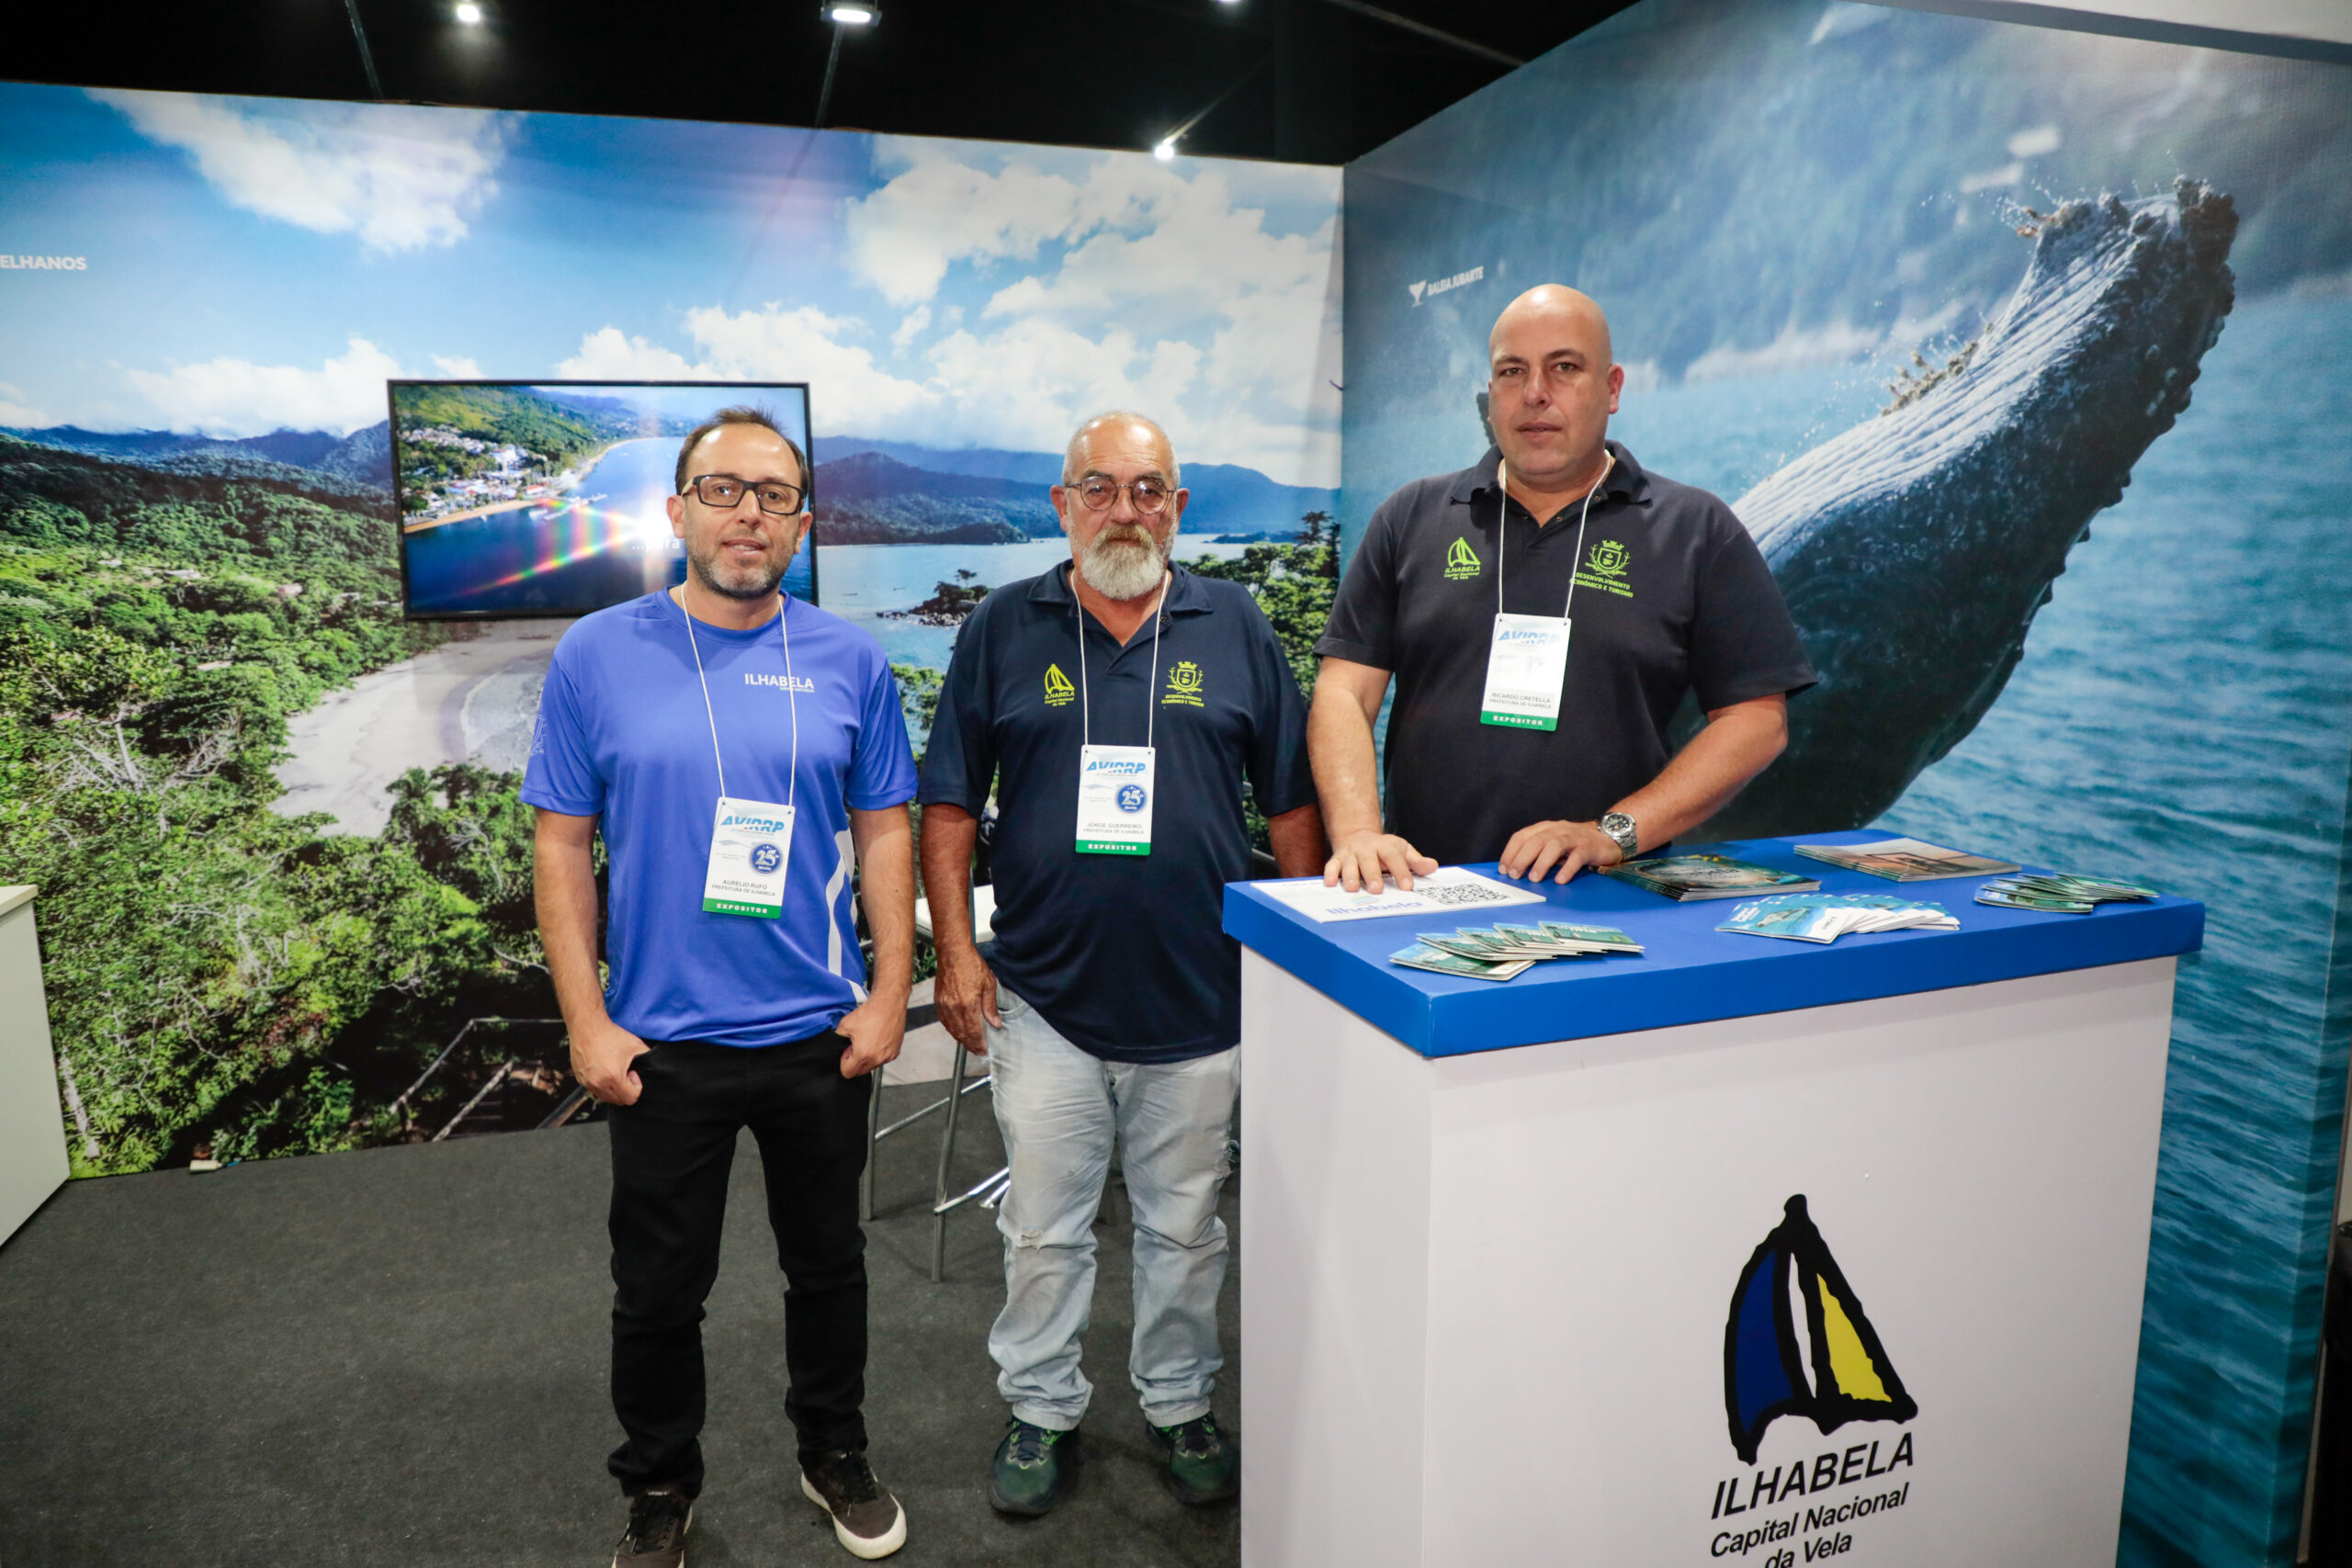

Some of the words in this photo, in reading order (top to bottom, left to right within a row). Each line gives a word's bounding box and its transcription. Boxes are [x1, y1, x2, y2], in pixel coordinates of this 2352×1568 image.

[744, 673, 815, 689] ILHABELA
[1493, 715, 1544, 726] EXPOSITOR
[1088, 843, 1137, 852] EXPOSITOR
[723, 879, 750, 888] AURELIO
[717, 903, 768, 914] EXPOSITOR
[1325, 901, 1423, 915] Ilhabela
[1712, 1432, 1913, 1519] ILHABELA
[1711, 1512, 1799, 1558] Capital
[1803, 1482, 1909, 1533] Nacional
[1765, 1548, 1795, 1568] da
[1804, 1532, 1852, 1562] Vela
